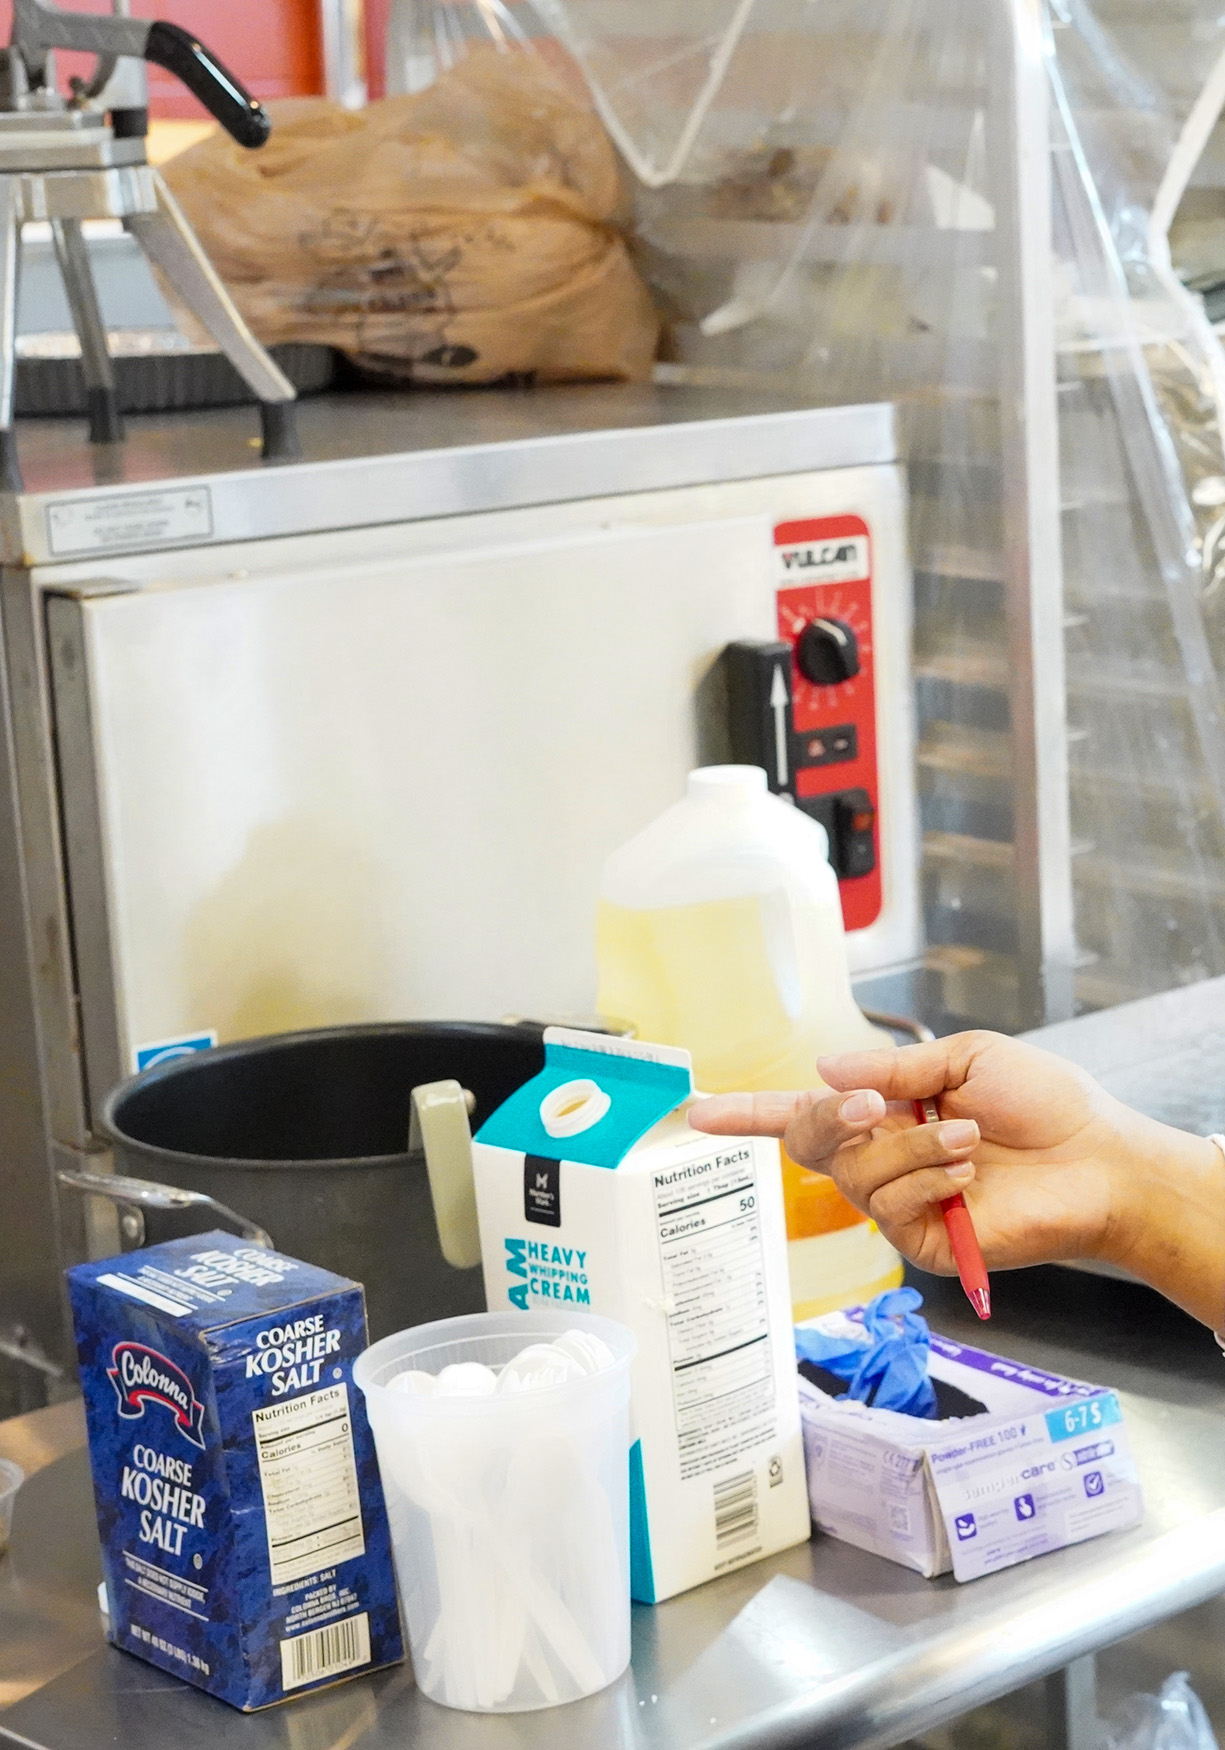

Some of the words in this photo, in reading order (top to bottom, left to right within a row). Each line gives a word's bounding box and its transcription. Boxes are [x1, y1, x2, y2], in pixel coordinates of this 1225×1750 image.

[782, 544, 857, 568] VULCAN
[654, 1161, 712, 1188] Nutrition
[715, 1149, 750, 1168] Facts
[660, 1218, 706, 1238] Calories
[740, 1196, 755, 1212] 50
[528, 1240, 587, 1269] HEAVY
[504, 1238, 530, 1311] AM
[528, 1263, 589, 1286] WHIPPING
[530, 1277, 591, 1306] CREAM
[256, 1314, 324, 1349] COARSE
[245, 1328, 341, 1378] KOSHER
[122, 1350, 189, 1410] Colonna
[271, 1358, 324, 1396] SALT
[255, 1400, 307, 1422] Nutrition
[310, 1389, 340, 1406] Facts
[1090, 1401, 1102, 1424] S
[261, 1442, 302, 1460] Calories
[341, 1422, 349, 1433] 0
[133, 1444, 192, 1487] COARSE
[121, 1466, 206, 1529] KOSHER
[139, 1510, 188, 1556] SALT
[320, 1569, 336, 1583] SALT
